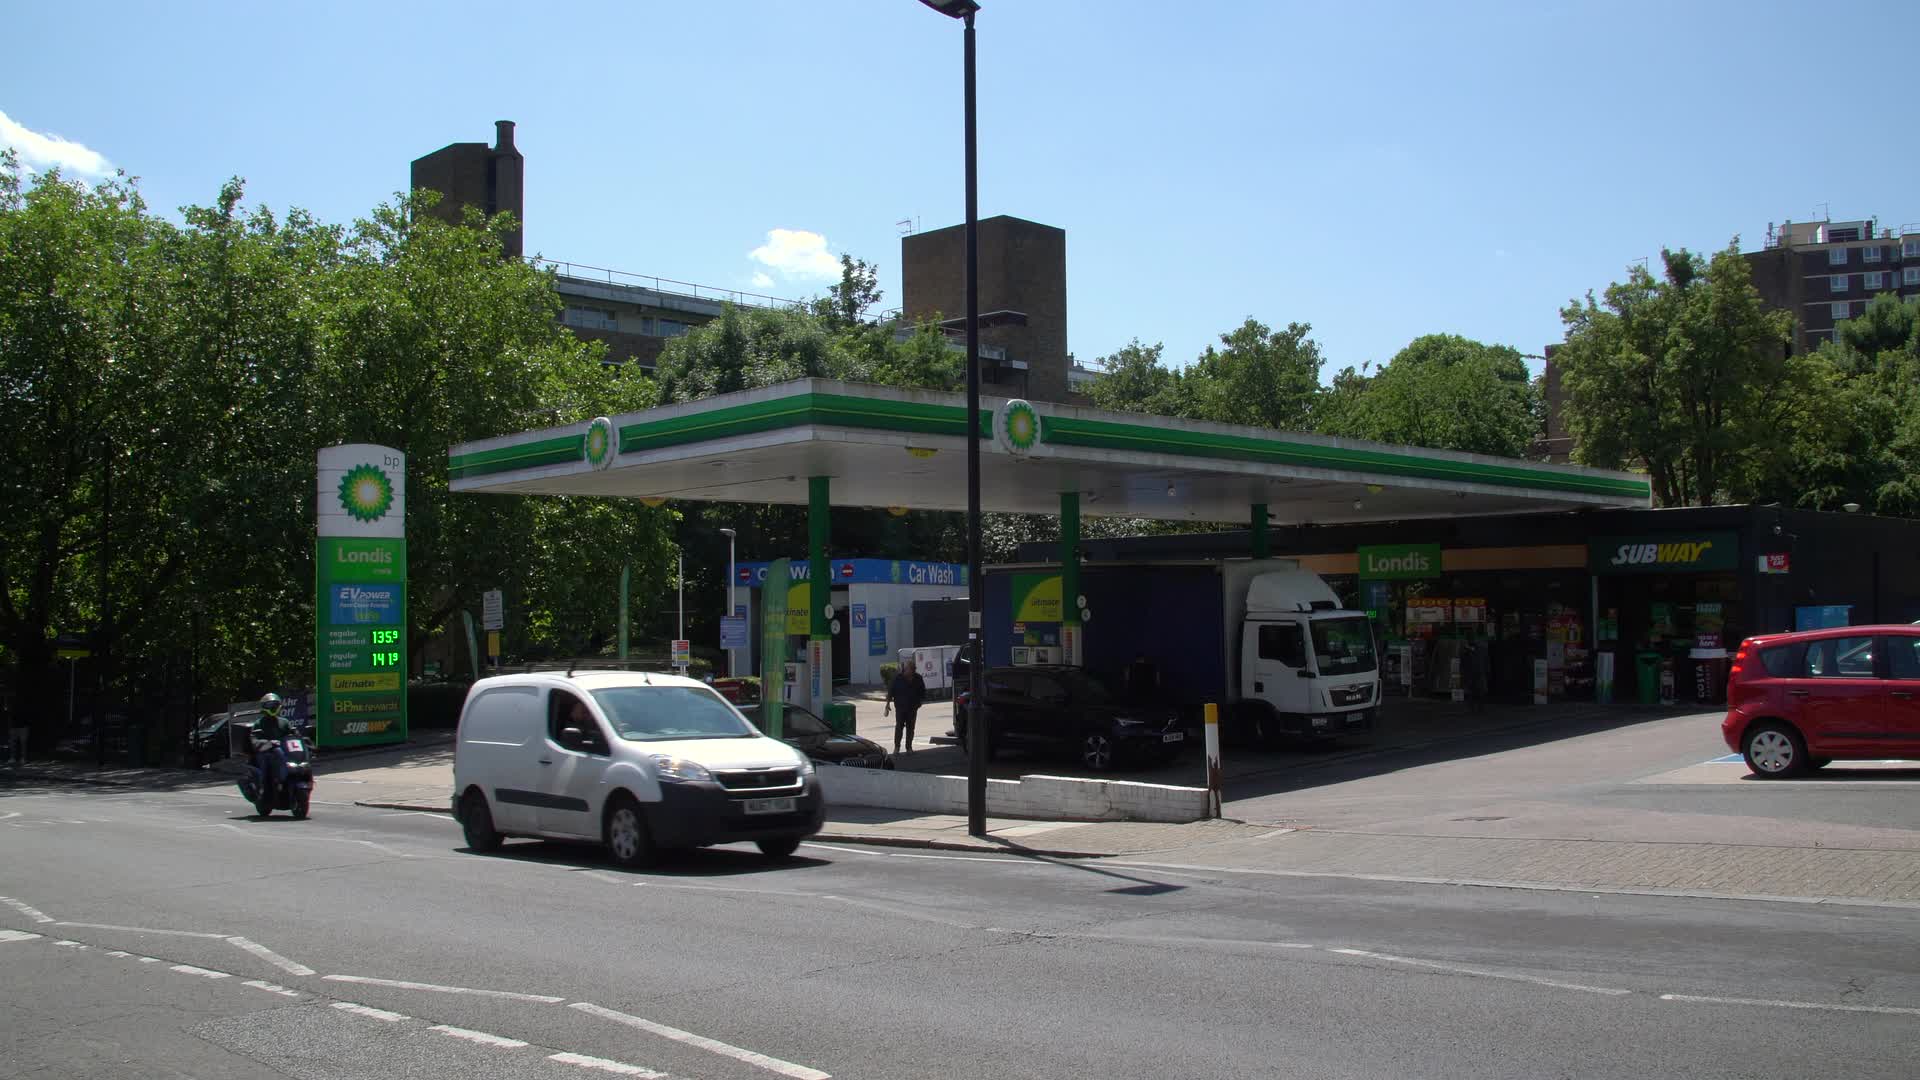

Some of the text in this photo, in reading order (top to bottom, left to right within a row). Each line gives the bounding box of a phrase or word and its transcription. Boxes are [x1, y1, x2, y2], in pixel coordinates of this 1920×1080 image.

[384, 454, 400, 469] bp
[338, 546, 393, 564] Londis
[1610, 540, 1713, 566] SUBWAY
[1367, 551, 1431, 573] Londis
[908, 563, 954, 585] Car Wash
[329, 651, 358, 660] regular
[329, 660, 352, 668] diesel
[343, 719, 393, 735] SUBWAY
